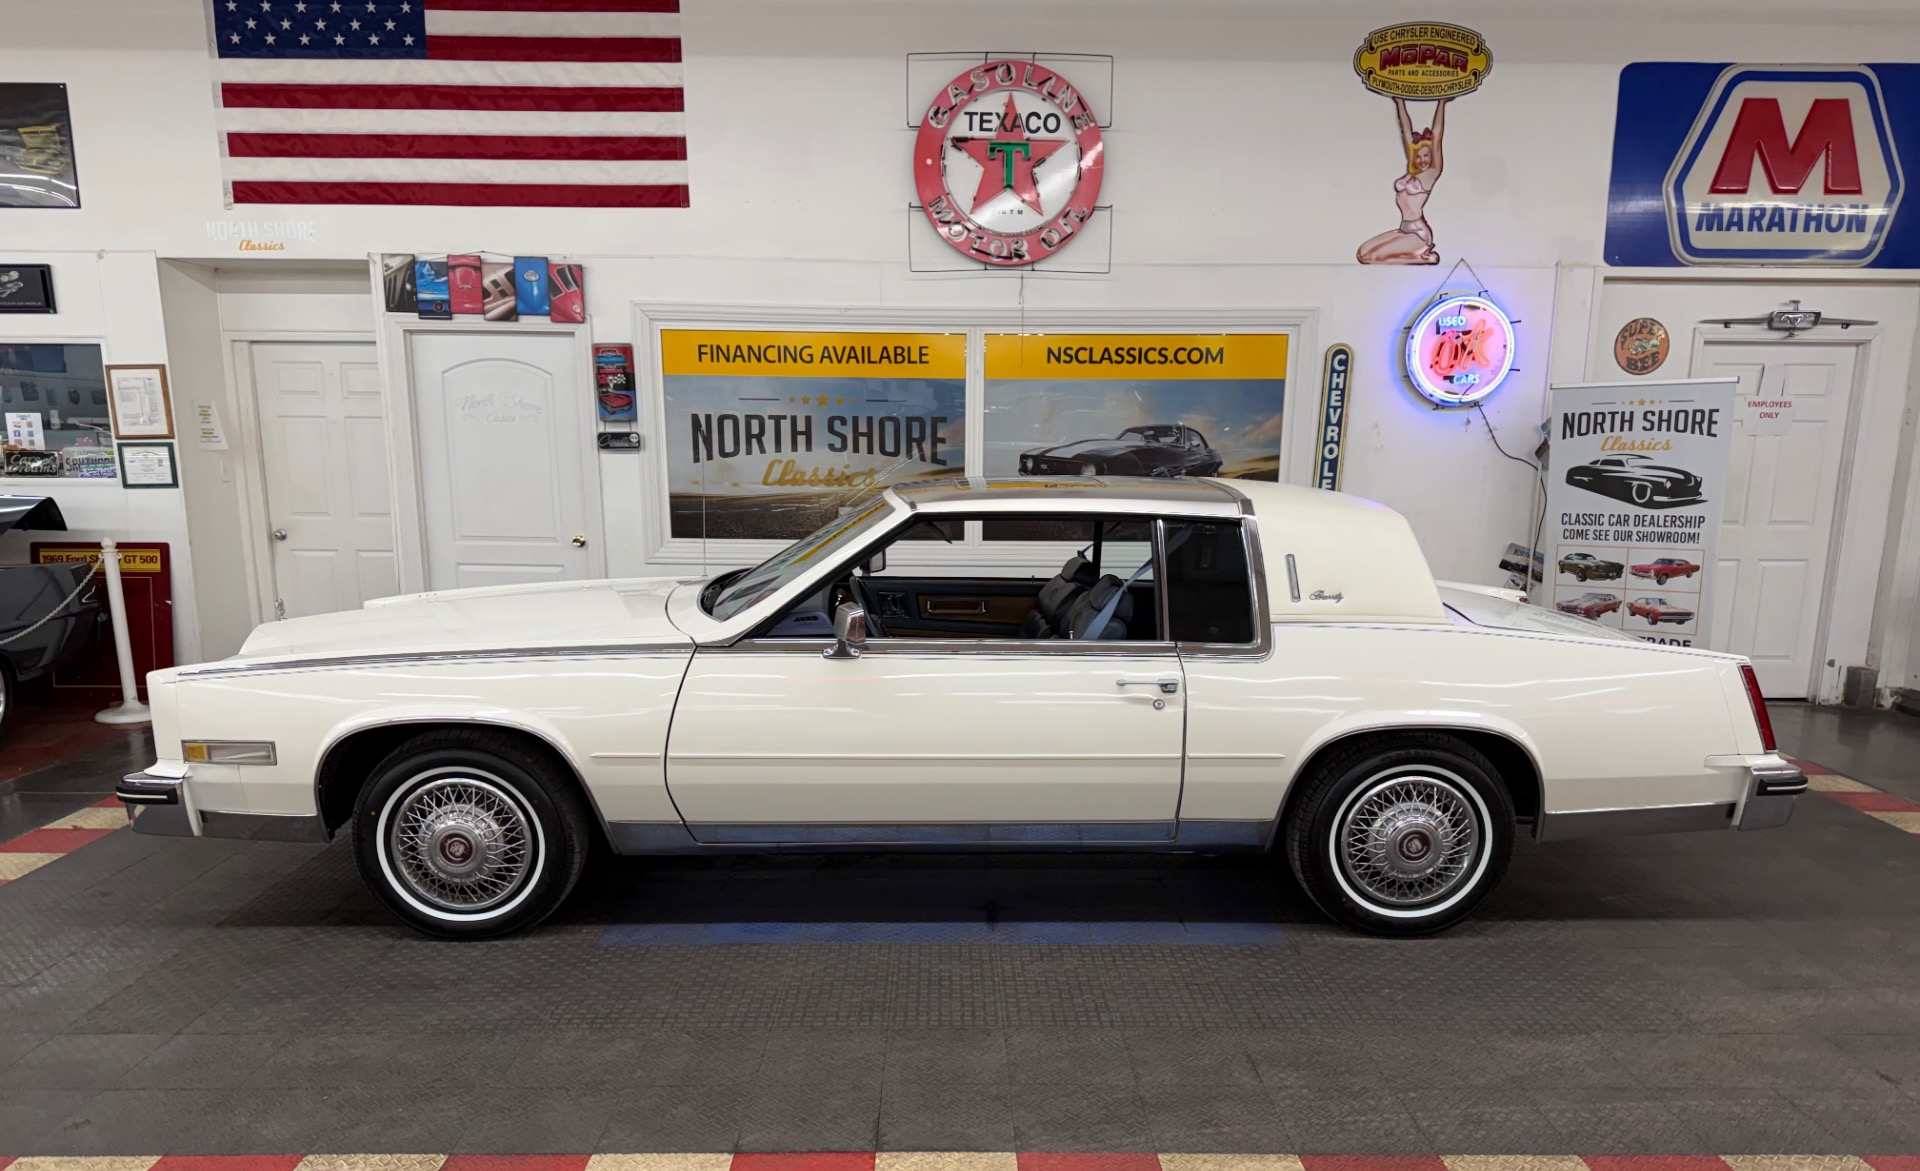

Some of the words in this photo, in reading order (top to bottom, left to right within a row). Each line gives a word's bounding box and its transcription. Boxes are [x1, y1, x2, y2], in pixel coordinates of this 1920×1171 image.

[1373, 32, 1389, 44] USE
[1390, 27, 1429, 40] CHRYSLER
[1430, 27, 1476, 46] ENGINEERED
[1380, 43, 1469, 74] MOPAR
[1407, 69, 1419, 77] AND
[1421, 69, 1460, 77] ACCESSORIES
[928, 61, 1095, 135] GASOLINE
[964, 111, 1061, 134] TEXACO
[1695, 203, 1869, 233] MARATHON
[928, 196, 1032, 262] MOTOR
[1040, 206, 1089, 250] OIL
[239, 239, 286, 251] Classics
[1438, 316, 1466, 327] USED
[697, 344, 814, 364] FINANCING
[819, 346, 930, 365] AVAILABLE
[1046, 346, 1224, 365] NSCLASSICS.COM
[1432, 319, 1494, 377] OK
[1453, 374, 1480, 385] CARS
[1562, 410, 1634, 441] NORTH
[1641, 408, 1719, 438] SHORE
[691, 413, 813, 464] NORTH
[827, 415, 948, 467] SHORE
[1600, 435, 1672, 451] Classics
[761, 458, 878, 488] Classics
[1561, 512, 1605, 527] CLASSIC
[1608, 514, 1630, 527] CAR
[1634, 514, 1705, 529] DEALERSHIP
[1563, 528, 1590, 541] COME
[1592, 529, 1610, 541] SEE
[1613, 530, 1633, 542] OUR
[1635, 530, 1700, 544] SHOWROOM!
[42, 554, 64, 564] 1969
[66, 554, 87, 563] Ford
[123, 555, 137, 564] GT
[139, 555, 158, 565] 500
